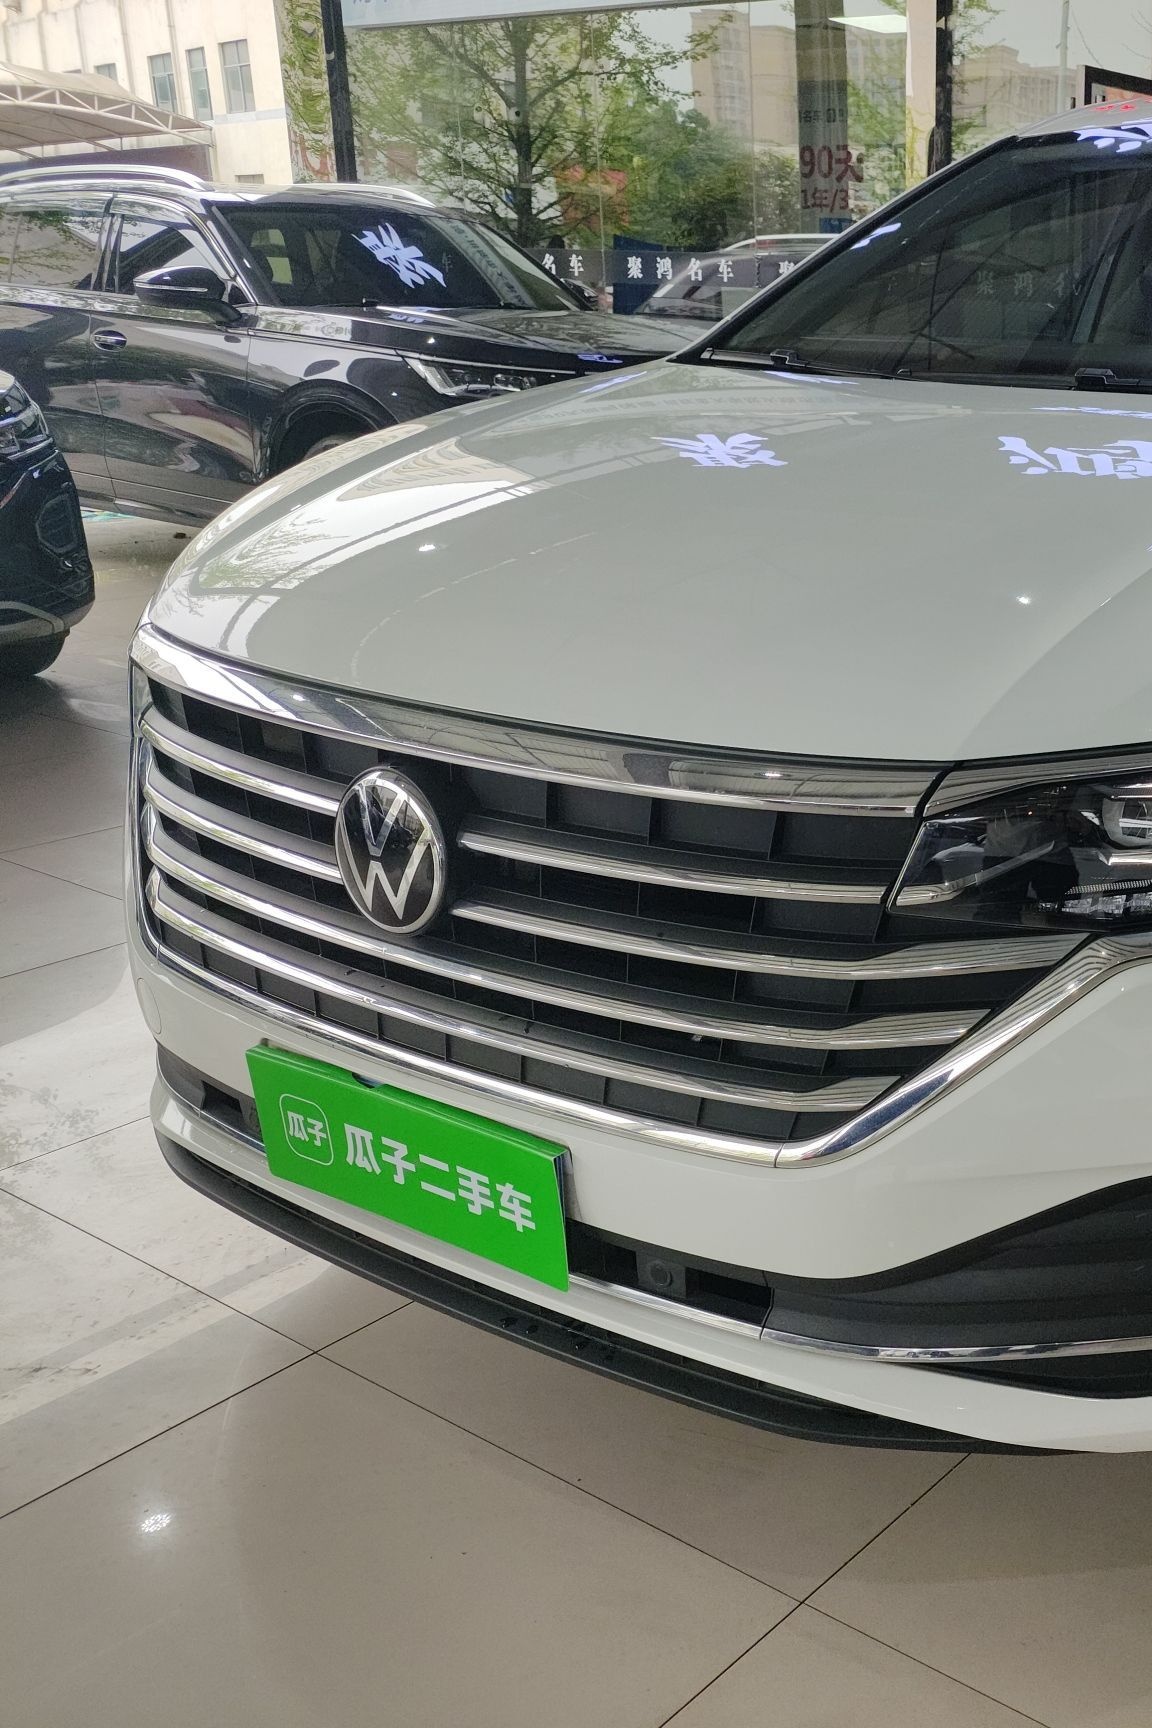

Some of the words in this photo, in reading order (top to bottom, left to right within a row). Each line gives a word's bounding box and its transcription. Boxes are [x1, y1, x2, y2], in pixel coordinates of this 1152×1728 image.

[627, 256, 734, 282] 聚鸿名车
[286, 1110, 328, 1148] 瓜子
[343, 1122, 537, 1234] 瓜子二手车
